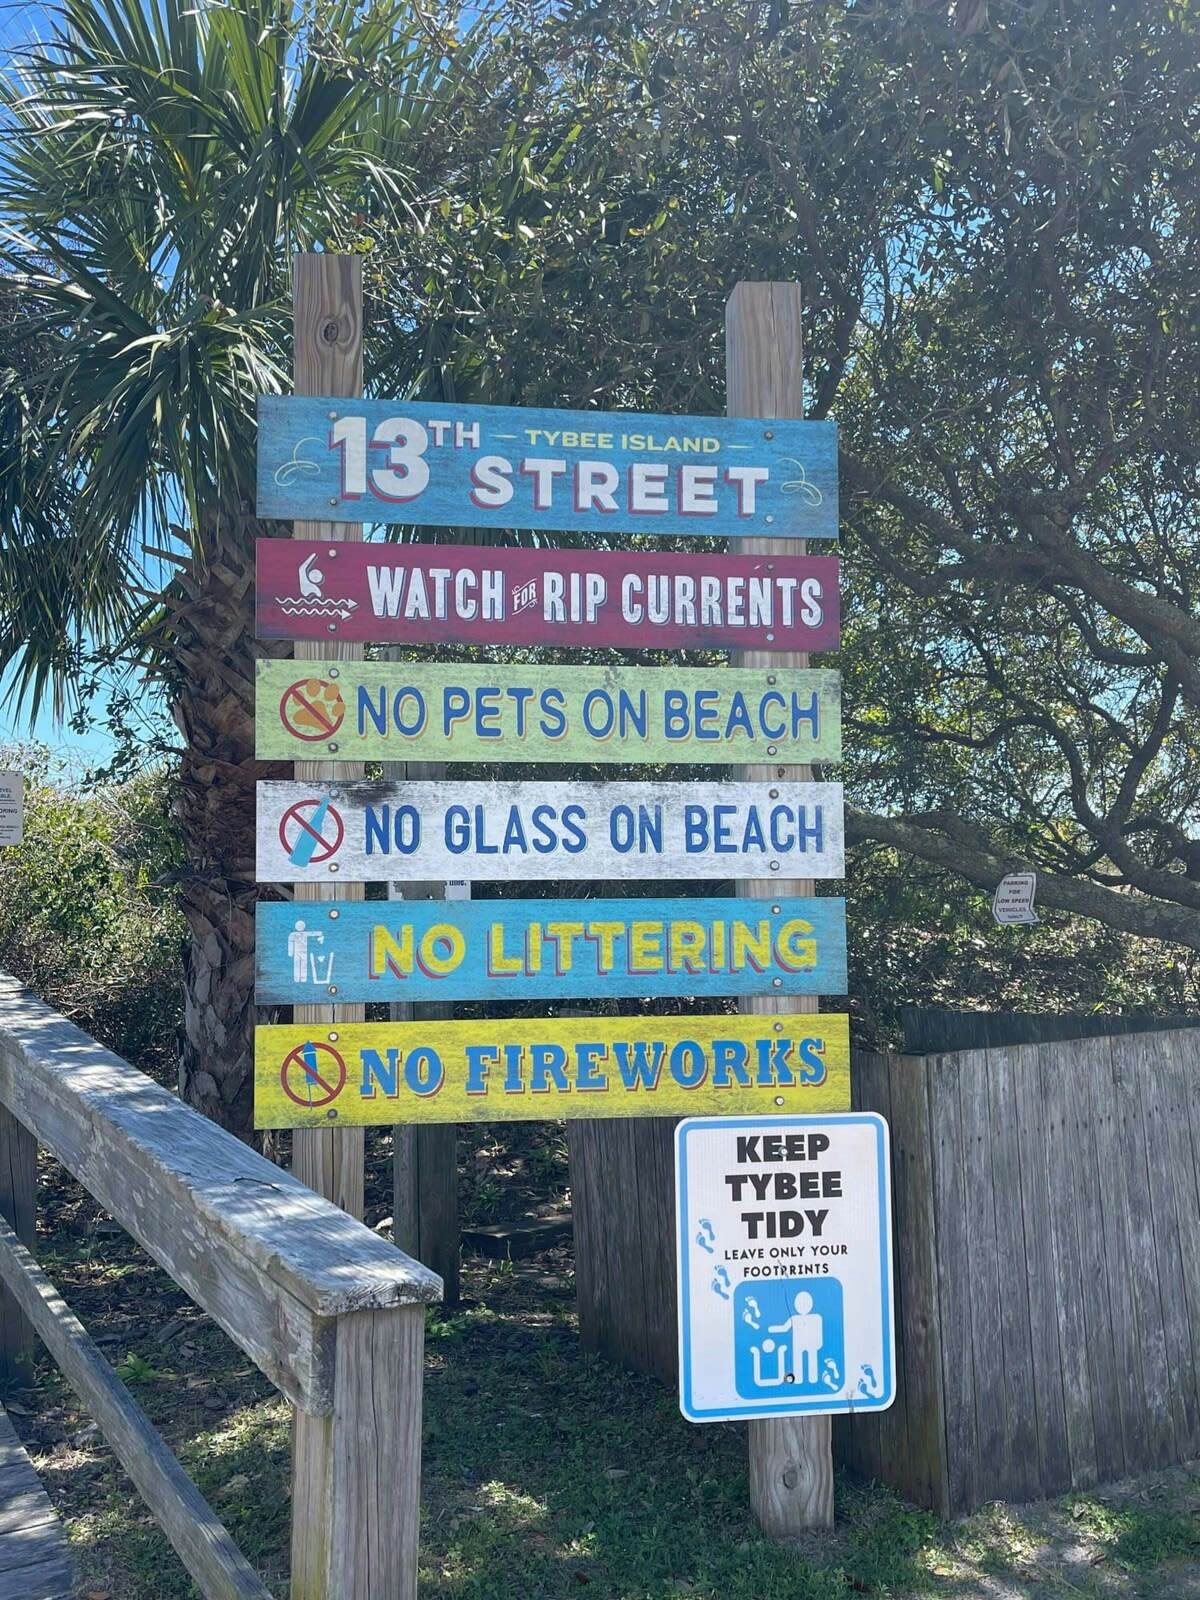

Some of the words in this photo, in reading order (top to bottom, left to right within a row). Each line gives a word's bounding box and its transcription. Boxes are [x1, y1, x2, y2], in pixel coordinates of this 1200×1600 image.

[525, 428, 614, 452] TYBEE
[622, 433, 721, 454] ISLAND
[470, 455, 769, 518] STREET
[366, 565, 506, 622] WATCH
[514, 582, 536, 611] FOR
[543, 571, 607, 624] RIP
[621, 574, 824, 628] CURRENTS
[358, 685, 428, 740] NO
[442, 686, 569, 741] PETS
[582, 688, 649, 741] ON
[664, 690, 820, 741] BEACH
[365, 805, 421, 855] NO
[444, 805, 588, 855] GLASS
[609, 804, 663, 854] ON
[684, 804, 823, 854] BEACH
[368, 923, 466, 980] NO
[487, 919, 818, 978] LITTERING
[360, 1045, 445, 1099] NO
[465, 1037, 828, 1095] FIREWORKS
[736, 1133, 830, 1163] KEEP
[725, 1171, 843, 1201] TYBEE
[741, 1209, 829, 1239] TIDY
[725, 1249, 765, 1260] LEAVE
[769, 1246, 805, 1258] ONLY
[811, 1245, 848, 1256] YOUR
[743, 1263, 829, 1278] FOOTPRINTS
